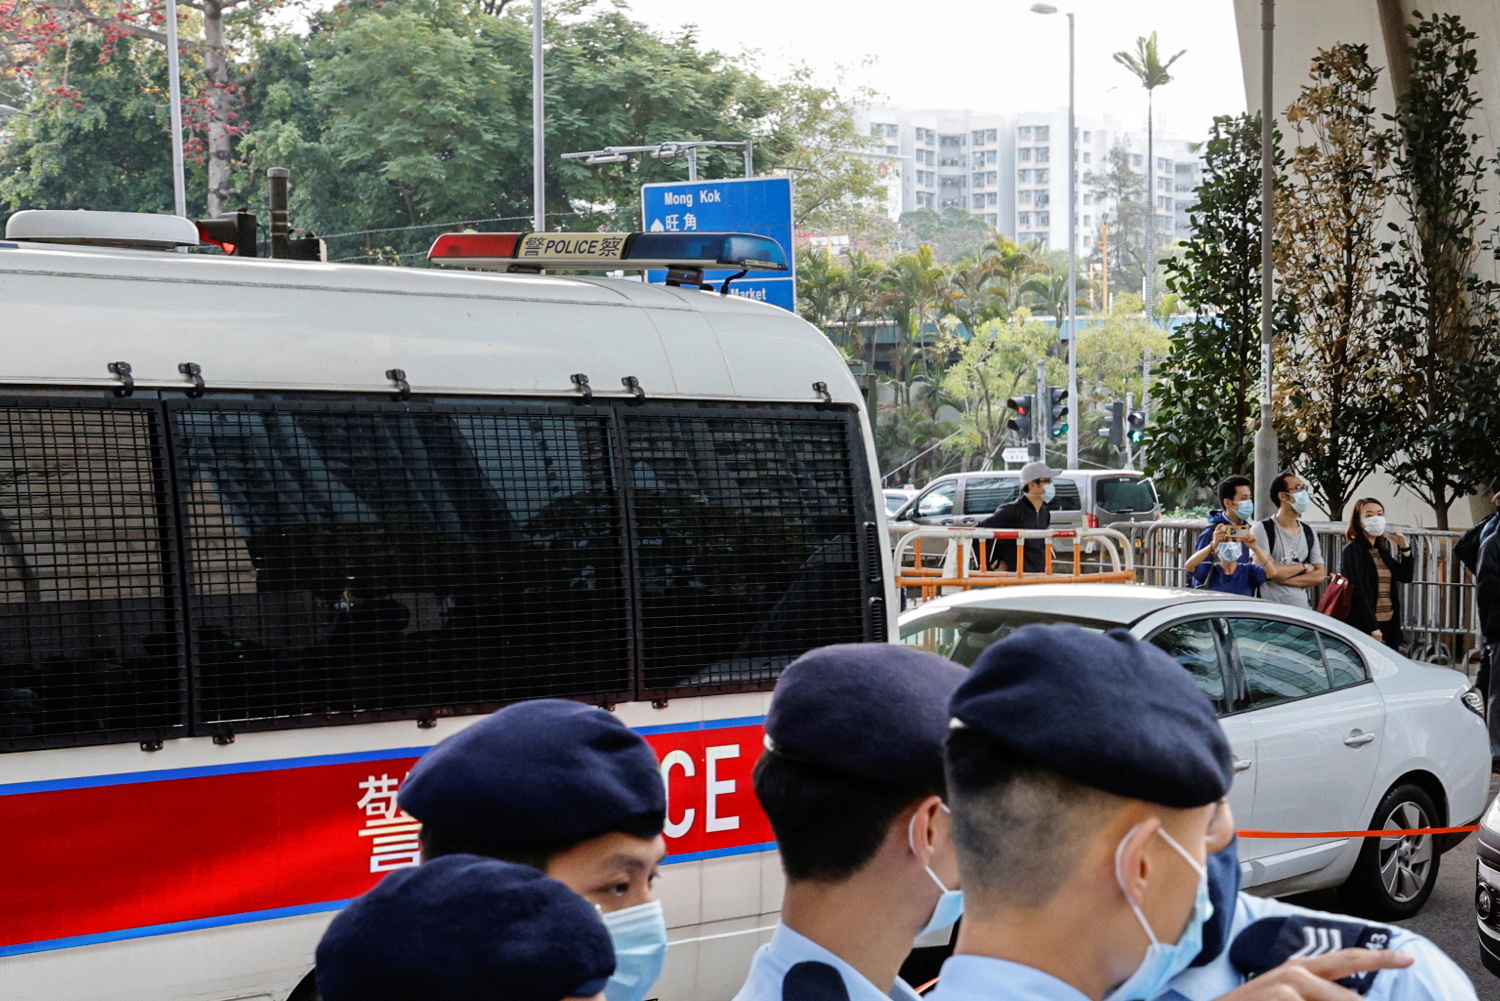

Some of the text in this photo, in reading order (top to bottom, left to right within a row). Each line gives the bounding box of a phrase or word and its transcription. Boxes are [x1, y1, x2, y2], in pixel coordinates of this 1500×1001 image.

[664, 190, 721, 207] Mong Kok
[665, 213, 697, 231] 旺角
[524, 237, 623, 257] 警 POLICE 察
[730, 287, 767, 301] Market
